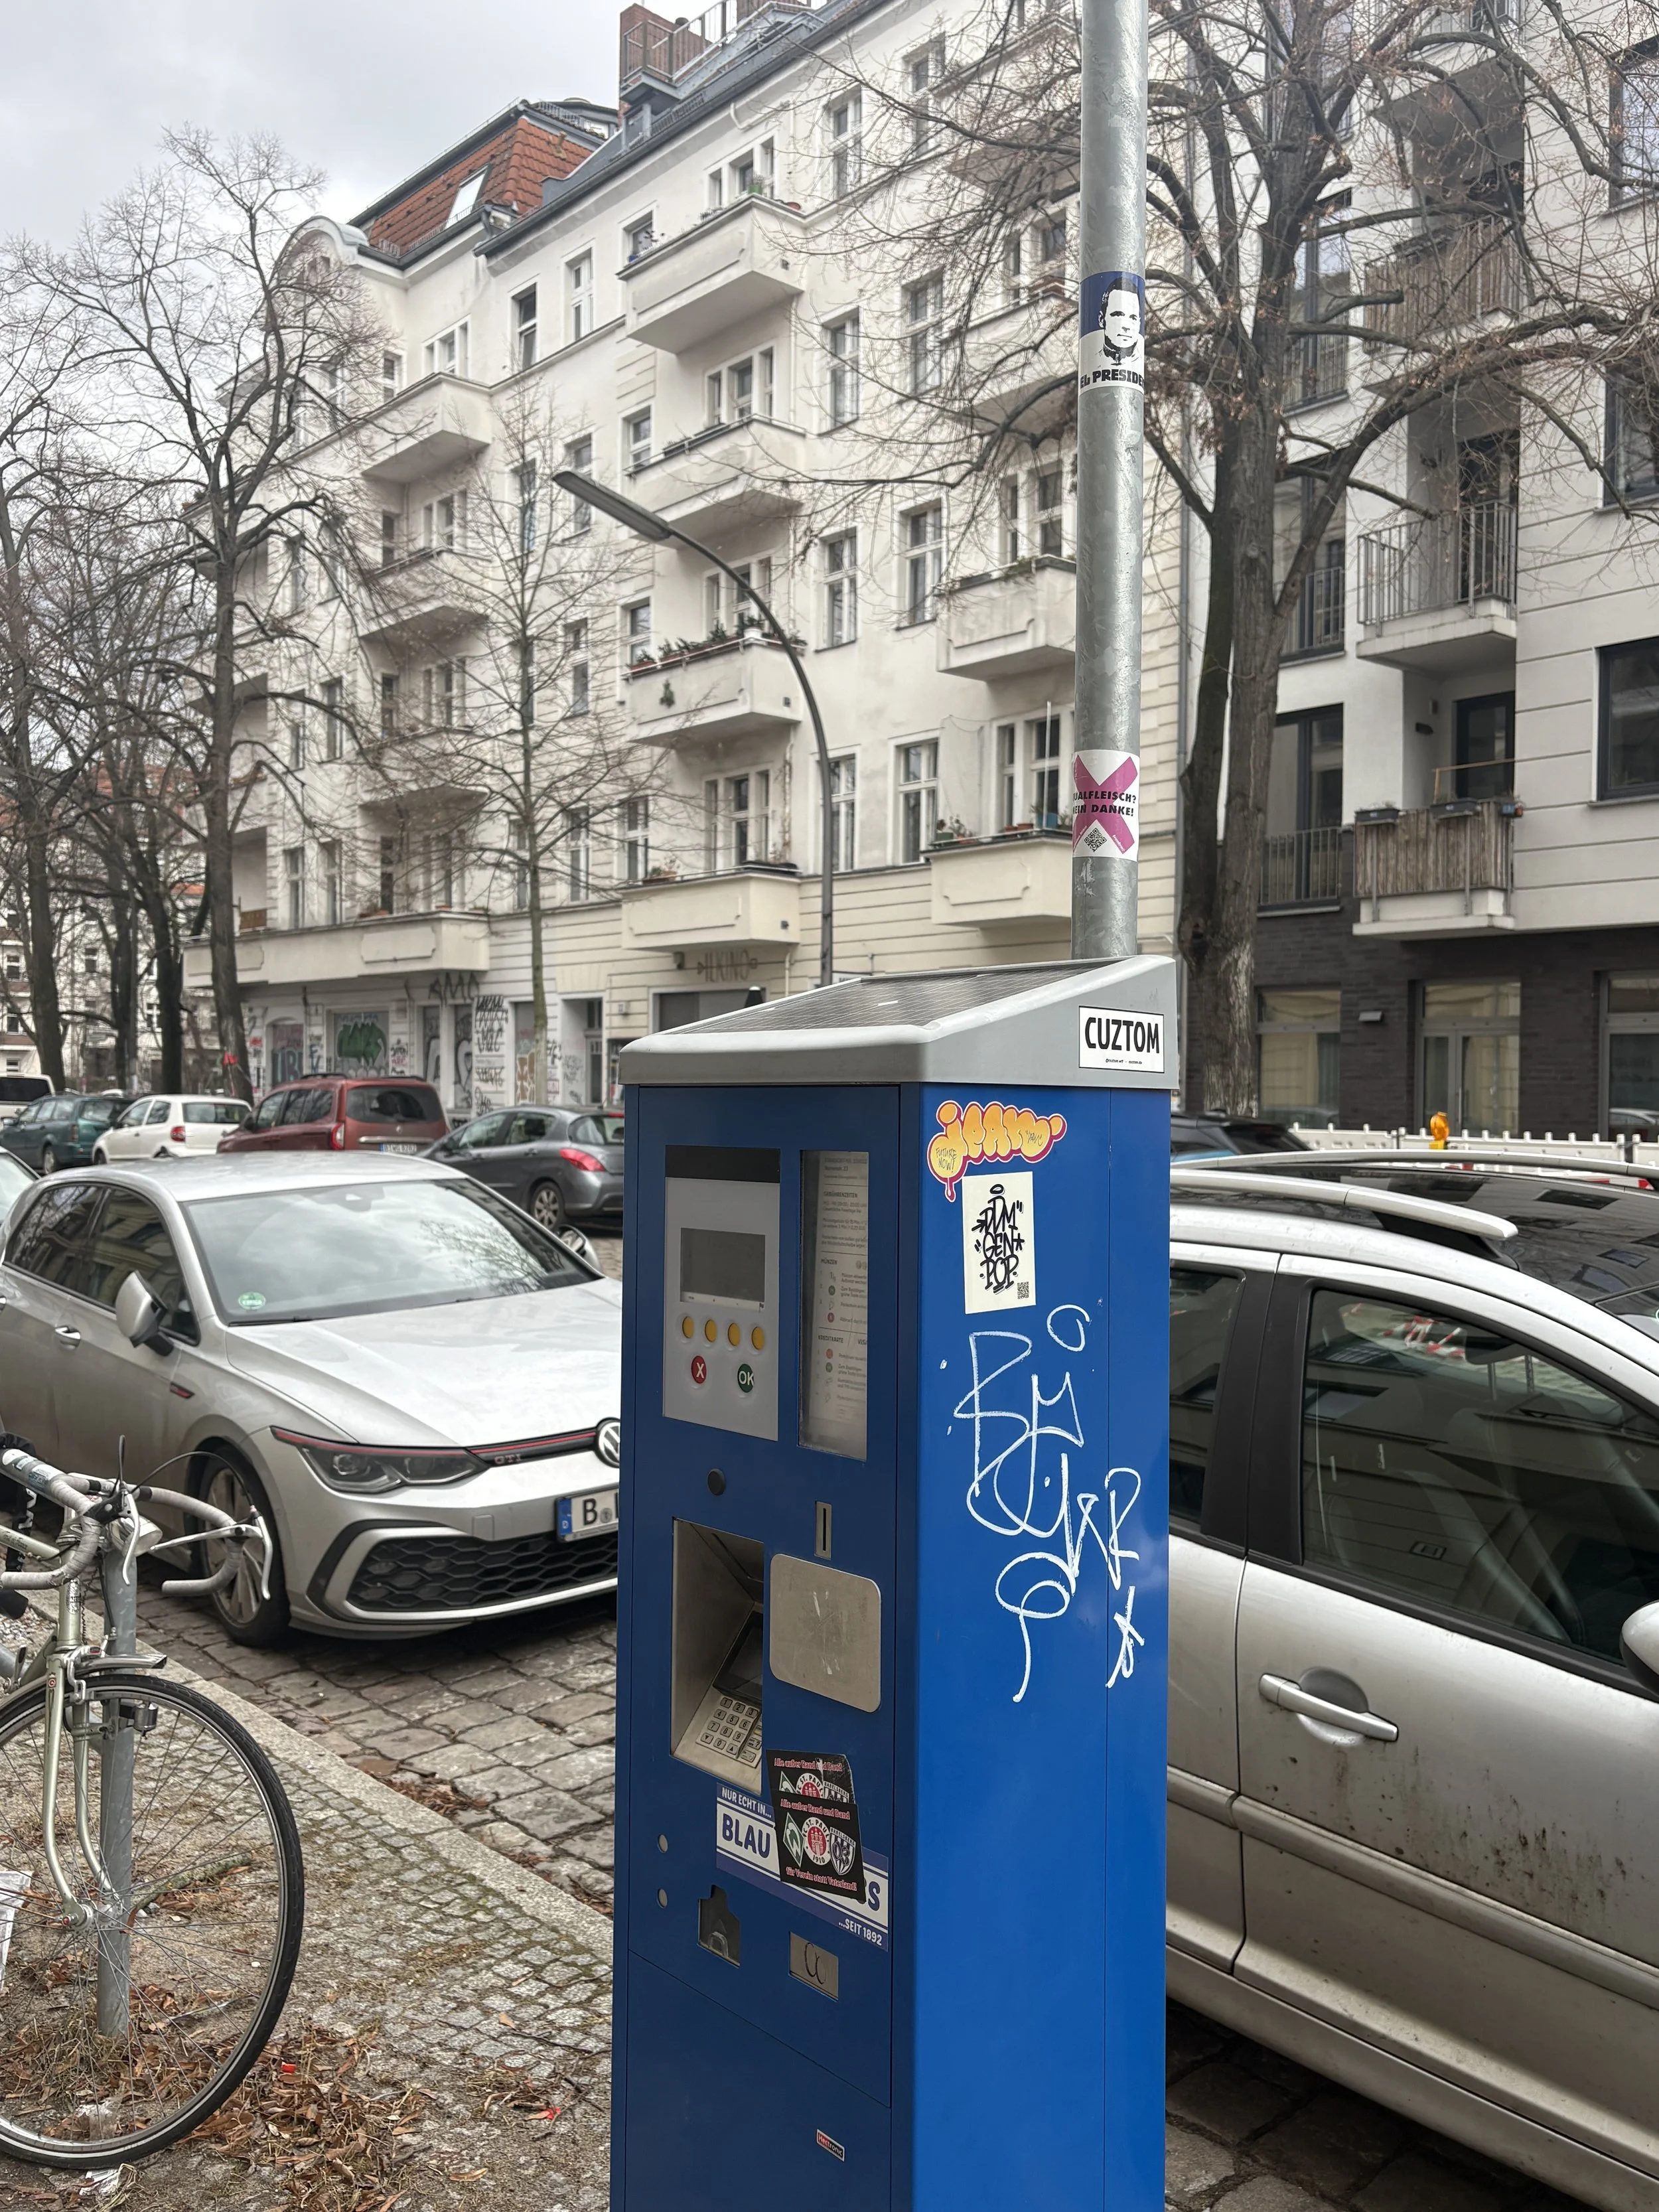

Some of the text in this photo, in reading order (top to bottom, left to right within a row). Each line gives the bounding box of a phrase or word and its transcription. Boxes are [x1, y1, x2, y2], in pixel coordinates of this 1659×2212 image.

[1080, 374, 1090, 389] EL
[1091, 804, 1133, 817] DANKE!
[1084, 1017, 1160, 1054] CUZTOM
[936, 1147, 957, 1160] FUTURE
[938, 1157, 955, 1173] NOW!
[739, 1370, 755, 1386] OK
[494, 1453, 523, 1465] GTI
[722, 1787, 737, 1803] NUR
[738, 1794, 757, 1811] ECHT
[823, 1807, 834, 1816] und
[806, 1818, 814, 1828] ST.
[722, 1813, 770, 1858] BLAU
[831, 1827, 855, 1846] BABELSBERG
[813, 1854, 826, 1864] 1910
[863, 1927, 882, 1946] 1892
[818, 2133, 842, 2156] Hectronic
